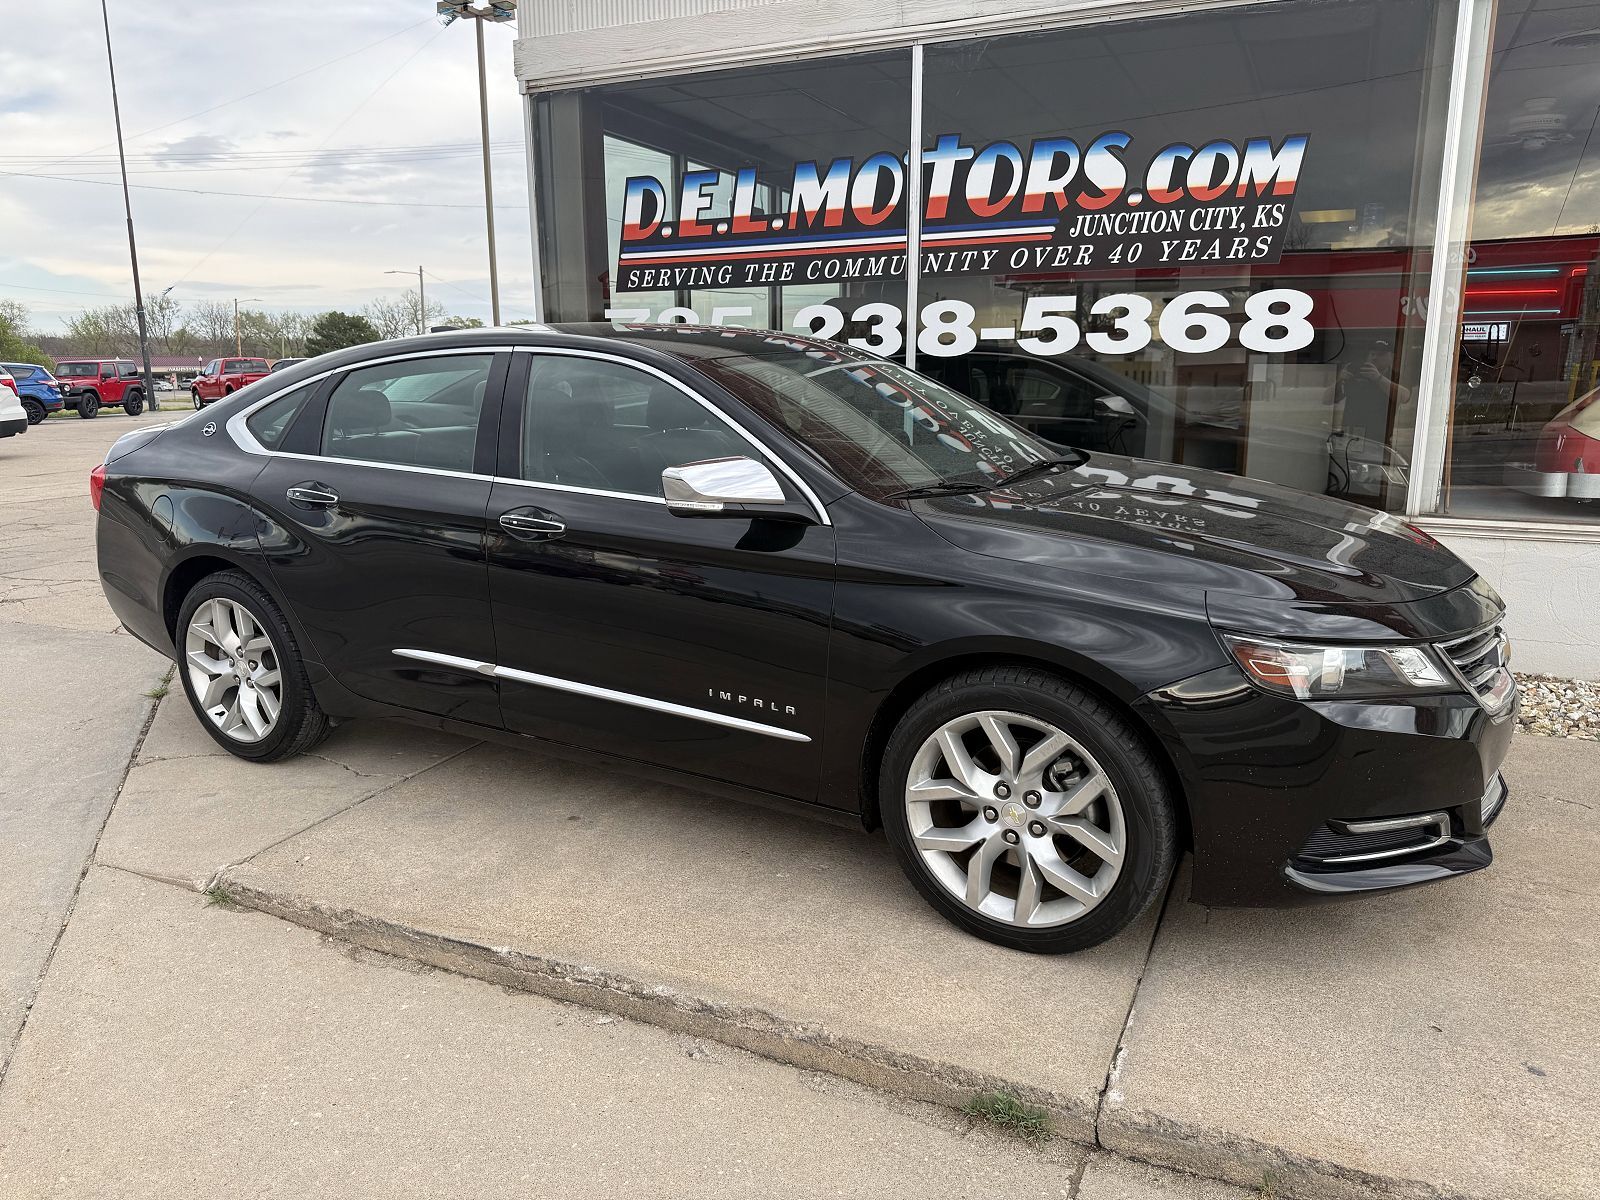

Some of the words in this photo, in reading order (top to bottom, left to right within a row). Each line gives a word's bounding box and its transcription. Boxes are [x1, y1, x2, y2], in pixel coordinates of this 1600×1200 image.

[1069, 209, 1184, 238] JUNCTION
[1189, 205, 1246, 233] CITY,
[1252, 203, 1286, 228] KS
[627, 264, 733, 288] SERVING
[745, 261, 795, 282] THE
[806, 249, 999, 280] COMMUNITY
[1009, 244, 1094, 269] OVER
[1108, 242, 1143, 264] 40
[1158, 235, 1273, 262] YEARS
[708, 688, 797, 715] IMPALA
